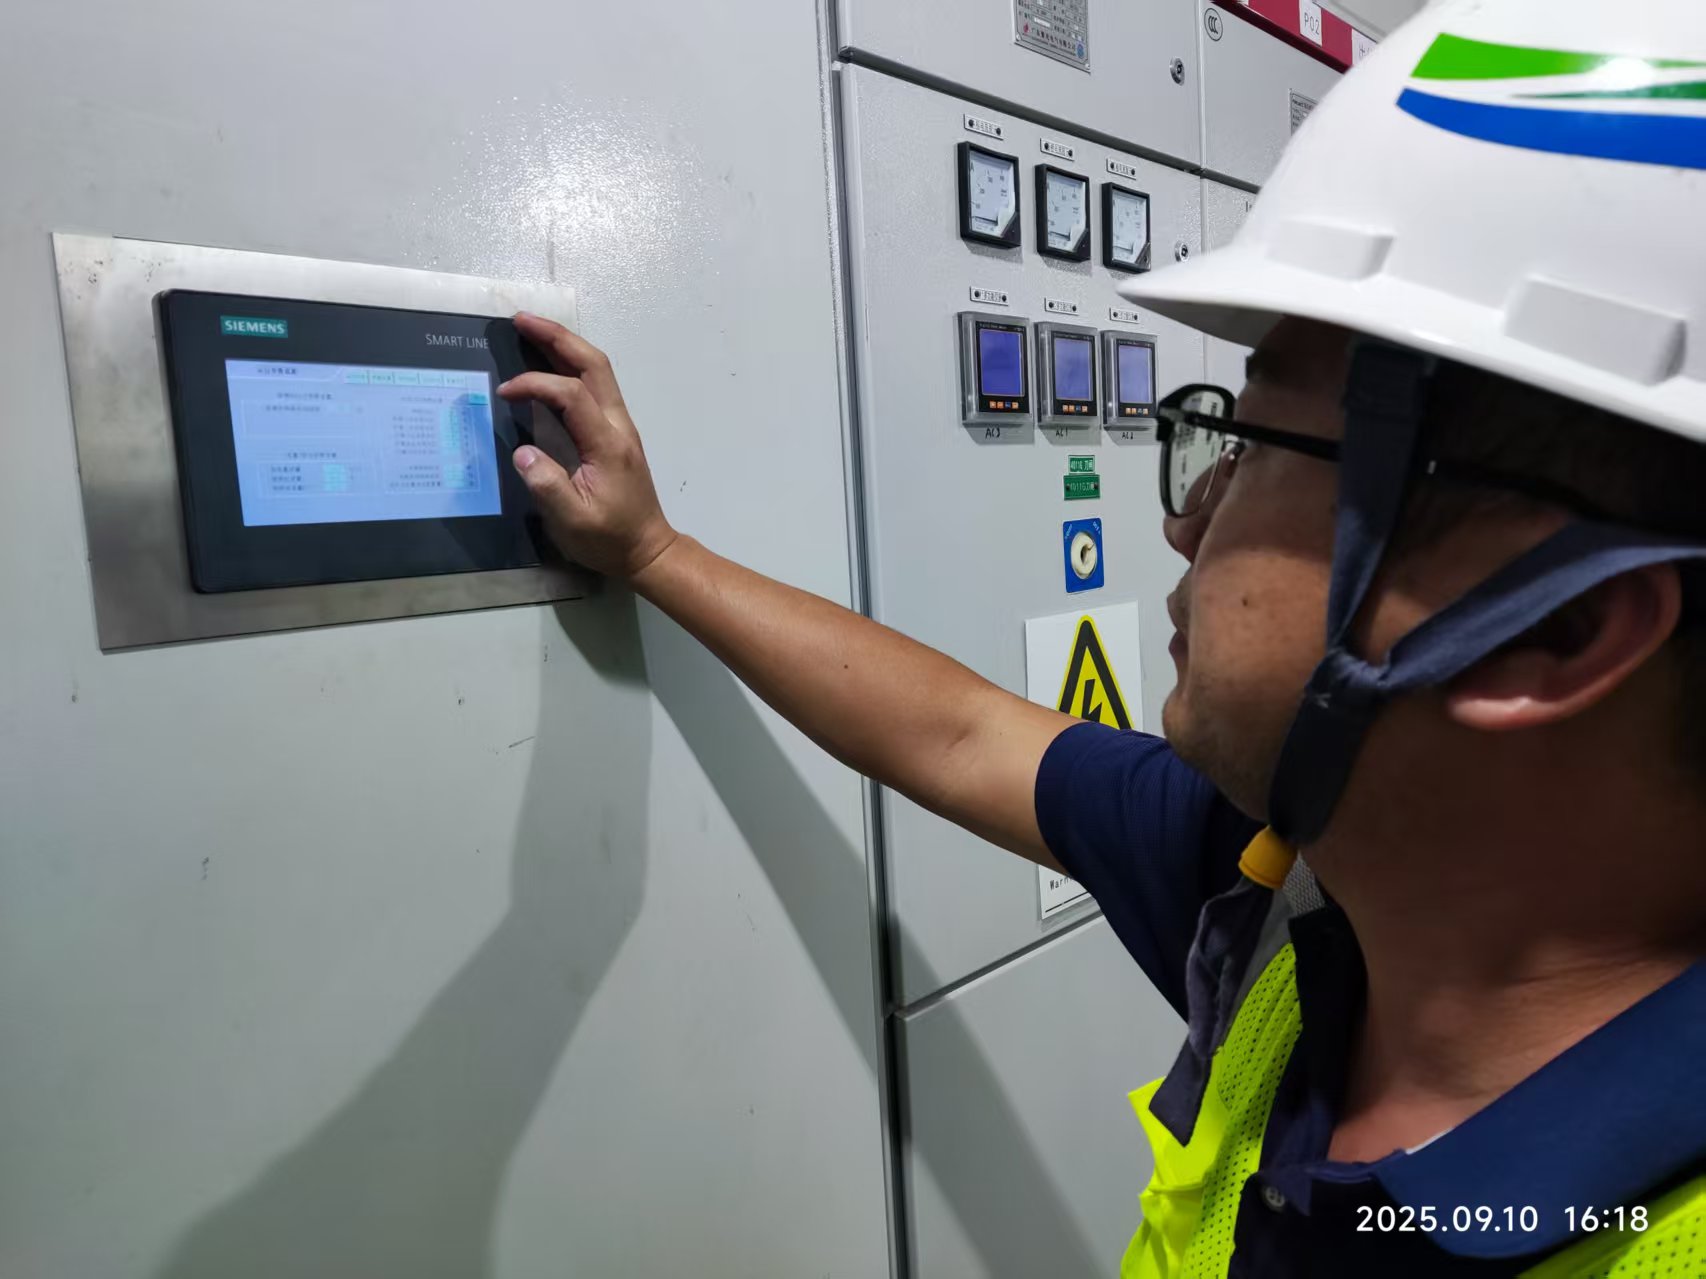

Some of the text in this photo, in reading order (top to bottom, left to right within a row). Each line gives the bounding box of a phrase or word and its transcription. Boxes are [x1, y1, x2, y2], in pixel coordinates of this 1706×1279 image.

[1304, 12, 1320, 35] P02
[224, 319, 286, 335] SIEMENS
[425, 334, 489, 349] SMART LINE
[1050, 877, 1070, 890] Warn
